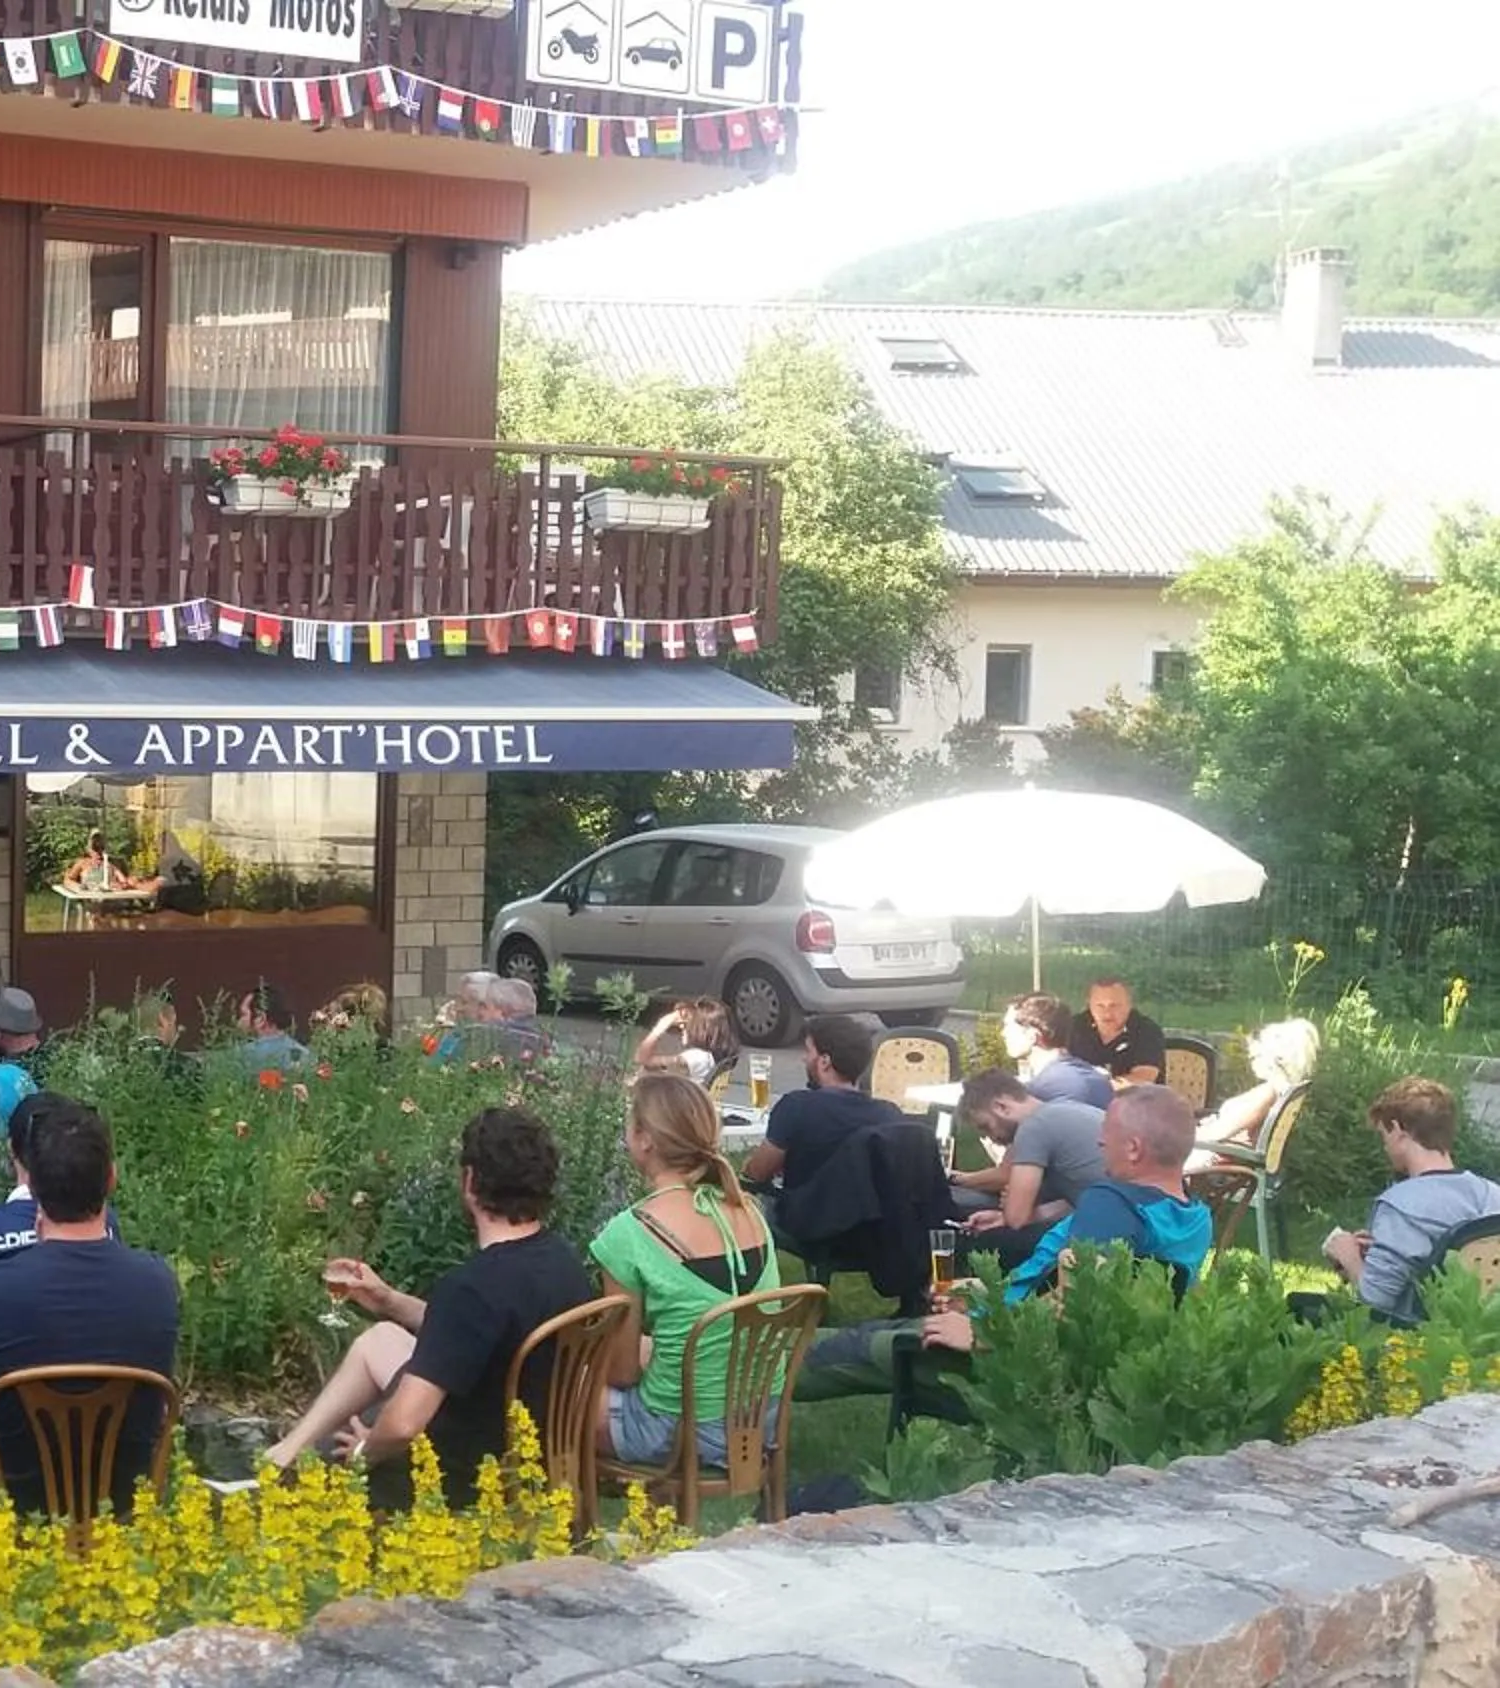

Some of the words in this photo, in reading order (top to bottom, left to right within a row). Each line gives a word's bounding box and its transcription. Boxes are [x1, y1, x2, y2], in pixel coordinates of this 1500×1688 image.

[711, 16, 757, 89] P
[65, 723, 111, 765] &
[134, 723, 553, 765] APPART'HOTEL
